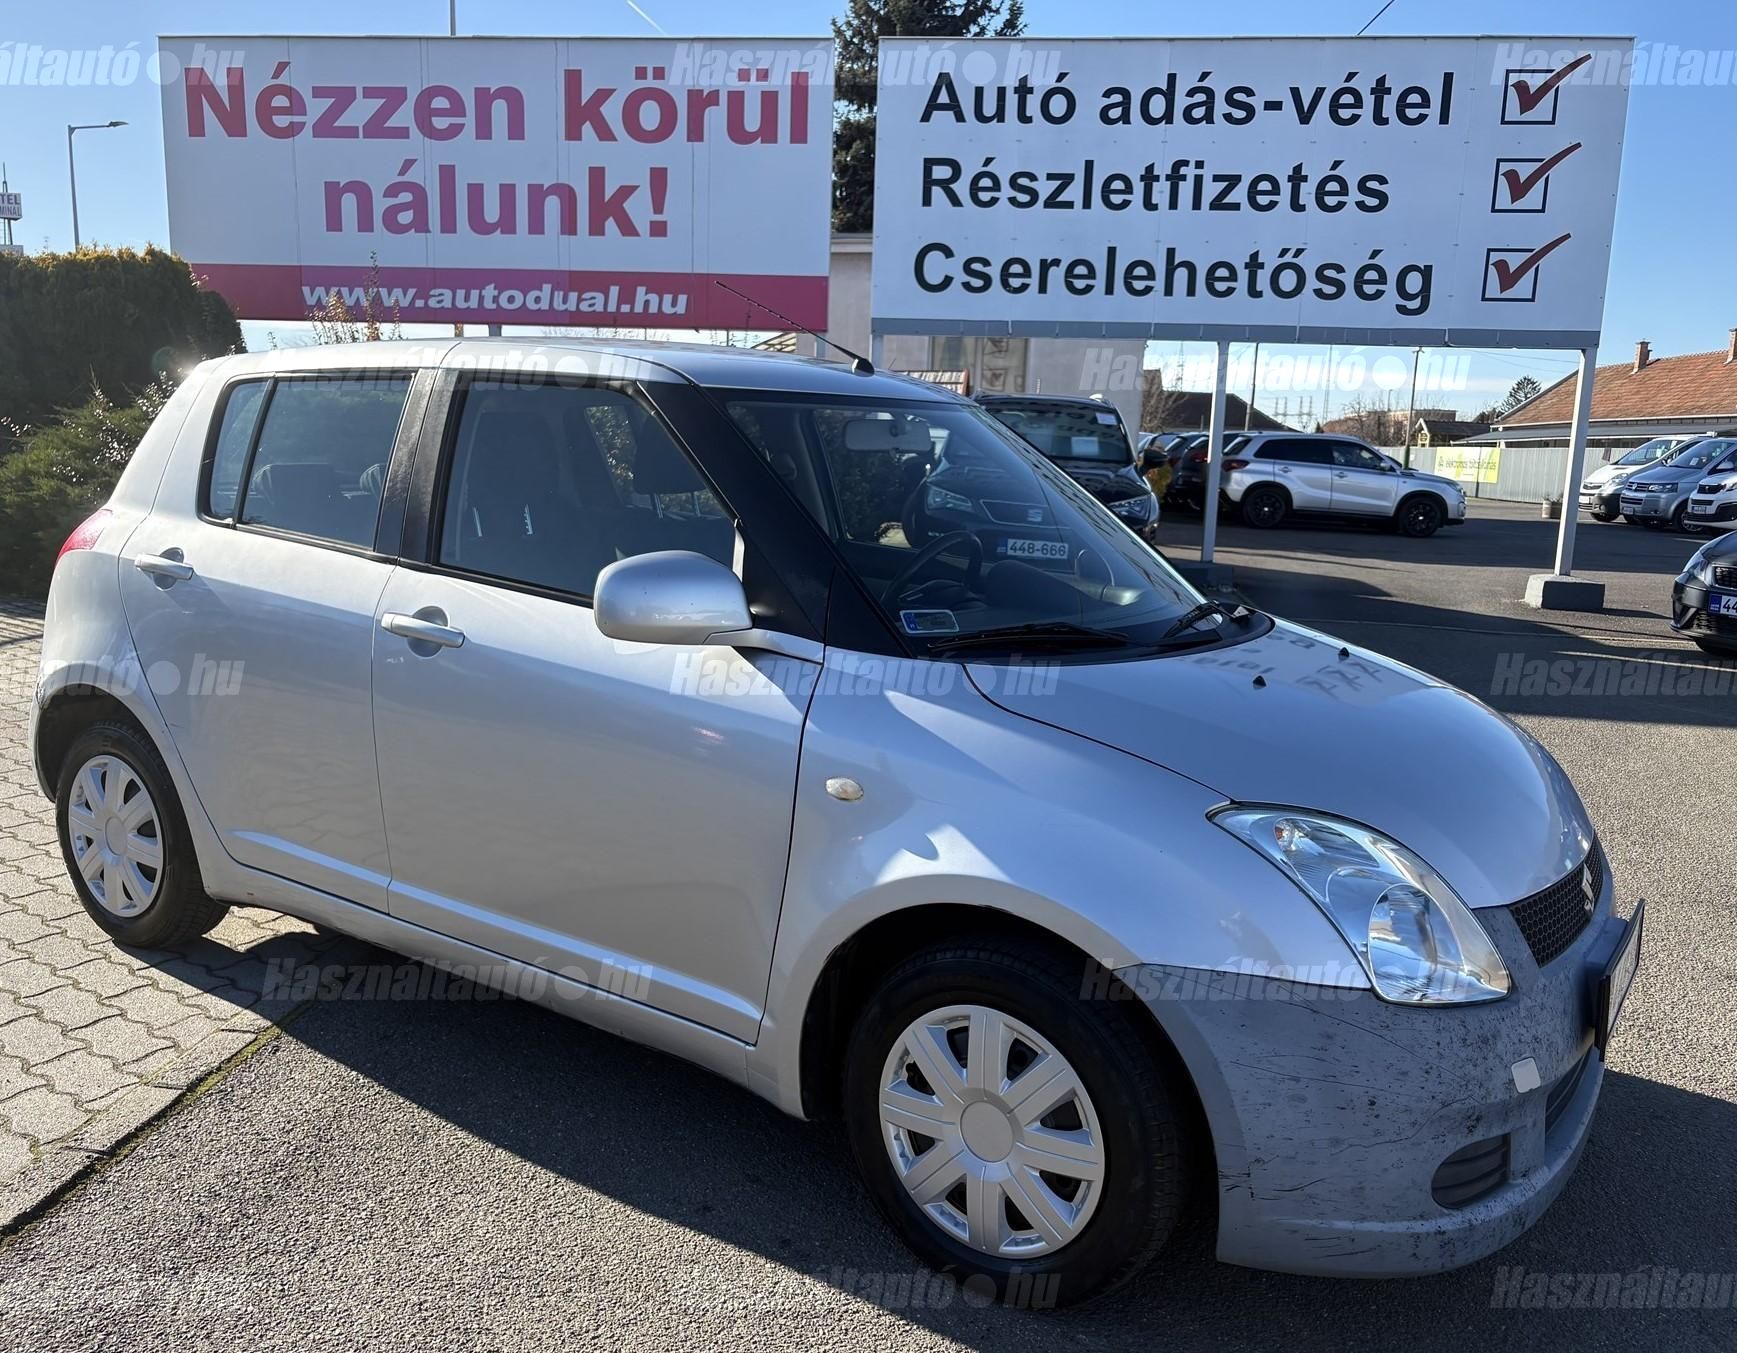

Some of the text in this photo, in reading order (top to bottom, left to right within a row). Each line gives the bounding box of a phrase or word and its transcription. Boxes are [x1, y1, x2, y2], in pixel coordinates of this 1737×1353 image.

[184, 62, 809, 145] Nézzen körül
[920, 72, 1454, 127] Autó adás-vétel
[324, 159, 669, 238] nálunk!
[922, 157, 1389, 213] Részletfizetés
[302, 283, 688, 315] www.autodual.hu
[914, 243, 1433, 315] Cserelehetőség
[1010, 541, 1067, 557] 448-666
